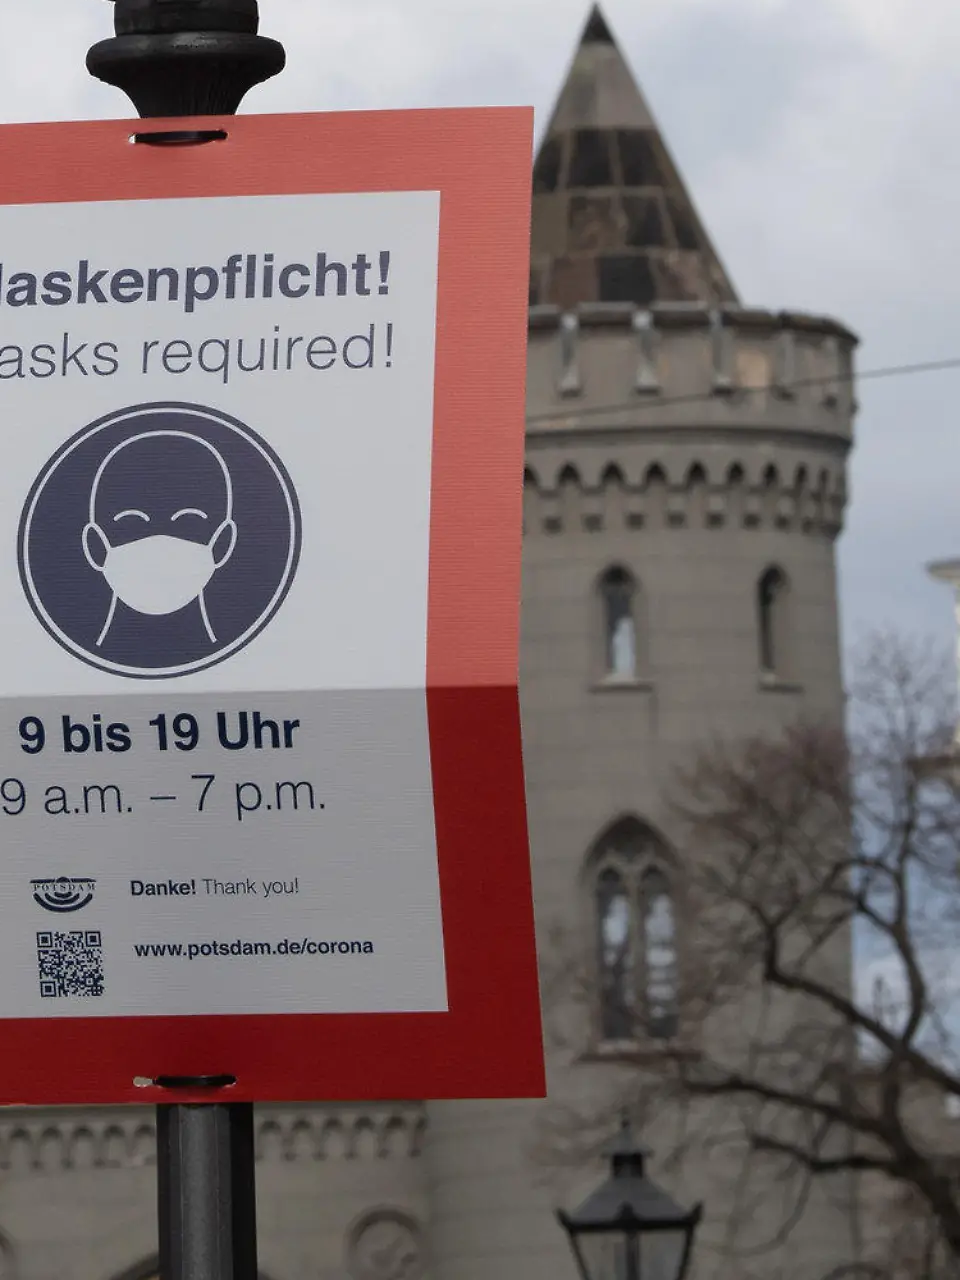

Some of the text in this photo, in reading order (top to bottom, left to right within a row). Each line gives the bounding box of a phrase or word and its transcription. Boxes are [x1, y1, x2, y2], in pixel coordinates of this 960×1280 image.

[143, 324, 392, 383] required!
[19, 712, 300, 754] 9 bis 19 Uhr
[1, 778, 25, 815] 9
[45, 785, 132, 814] a.m.
[192, 775, 215, 811] 7
[236, 782, 324, 821] p.m.
[33, 883, 96, 892] POTSDAM
[131, 878, 297, 897] Danke! Thank you!
[134, 938, 373, 960] www.potsdam.de/corona
